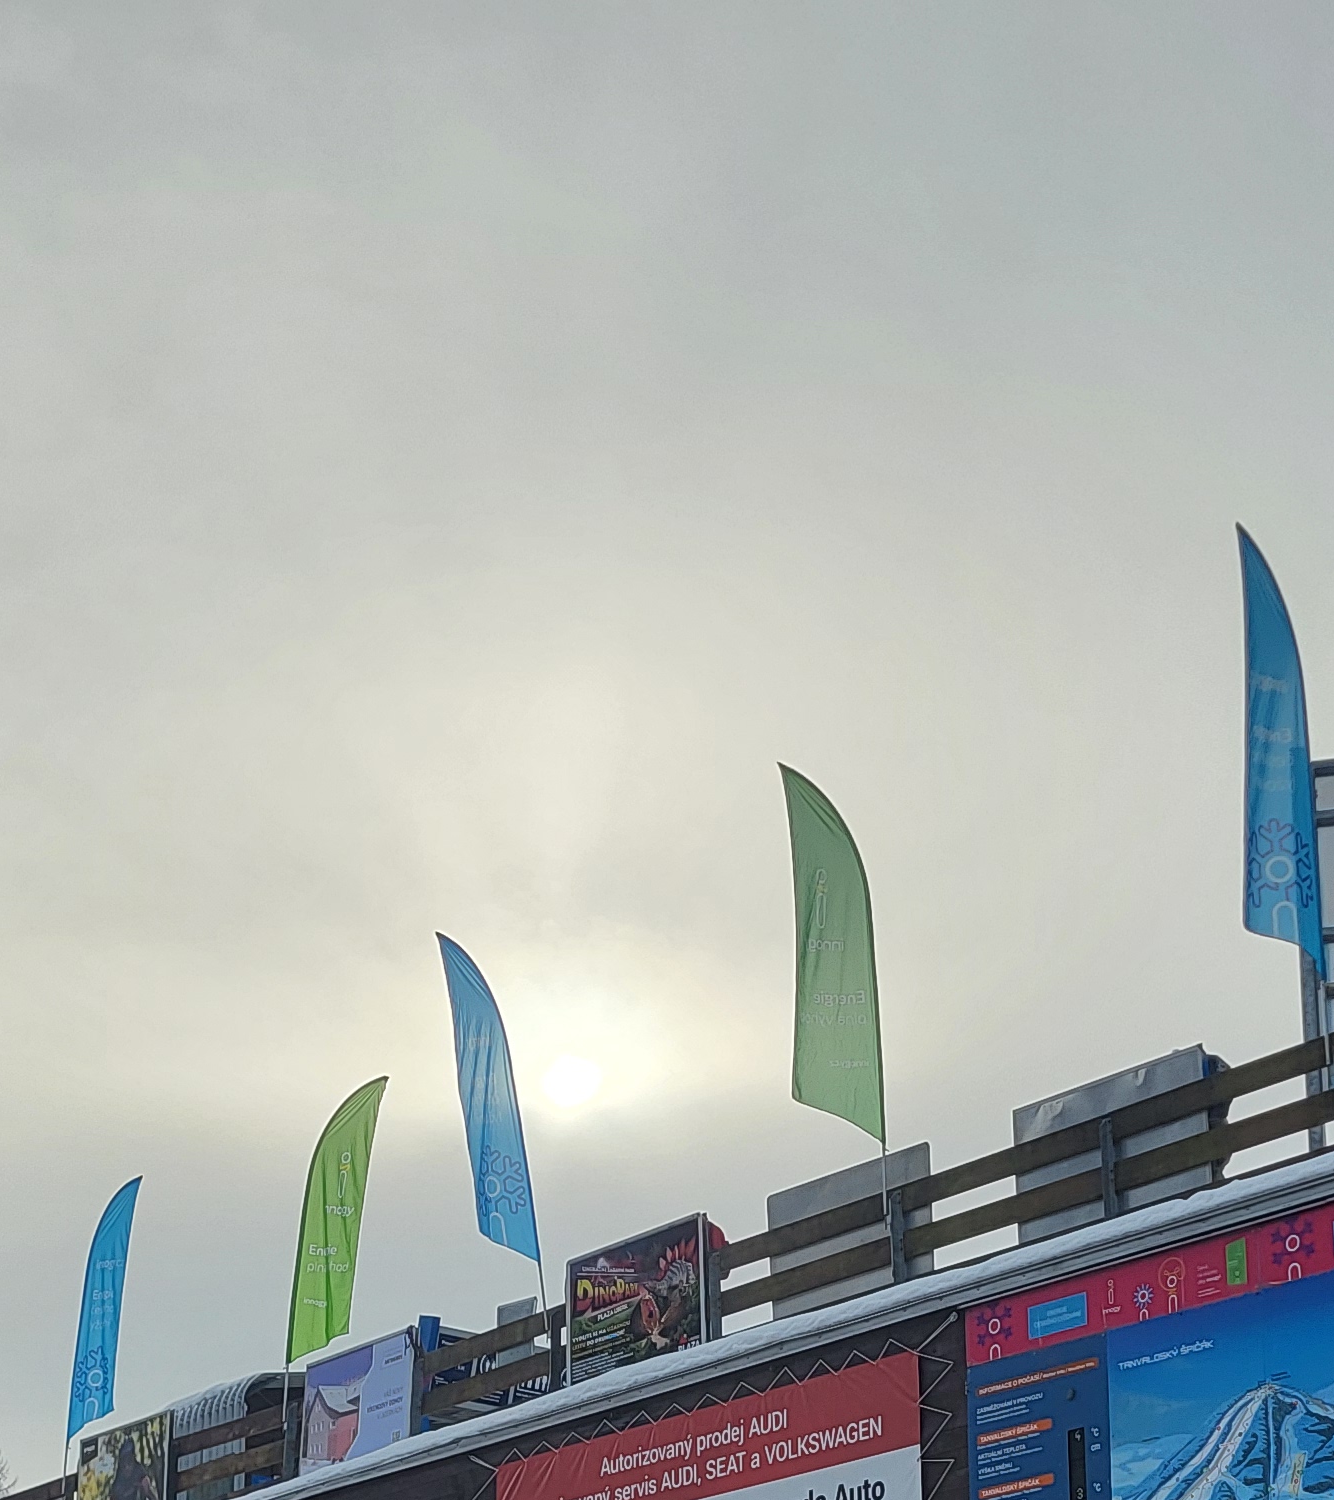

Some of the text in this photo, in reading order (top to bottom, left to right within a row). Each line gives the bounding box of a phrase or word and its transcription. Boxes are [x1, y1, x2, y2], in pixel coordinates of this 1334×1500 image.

[600, 1408, 788, 1477] Autorizovaný prodej AUDI
[661, 1463, 702, 1493] AUDI,
[705, 1452, 746, 1480] SEAT
[750, 1451, 761, 1469] a
[764, 1415, 883, 1466] VOLKSWAGEN
